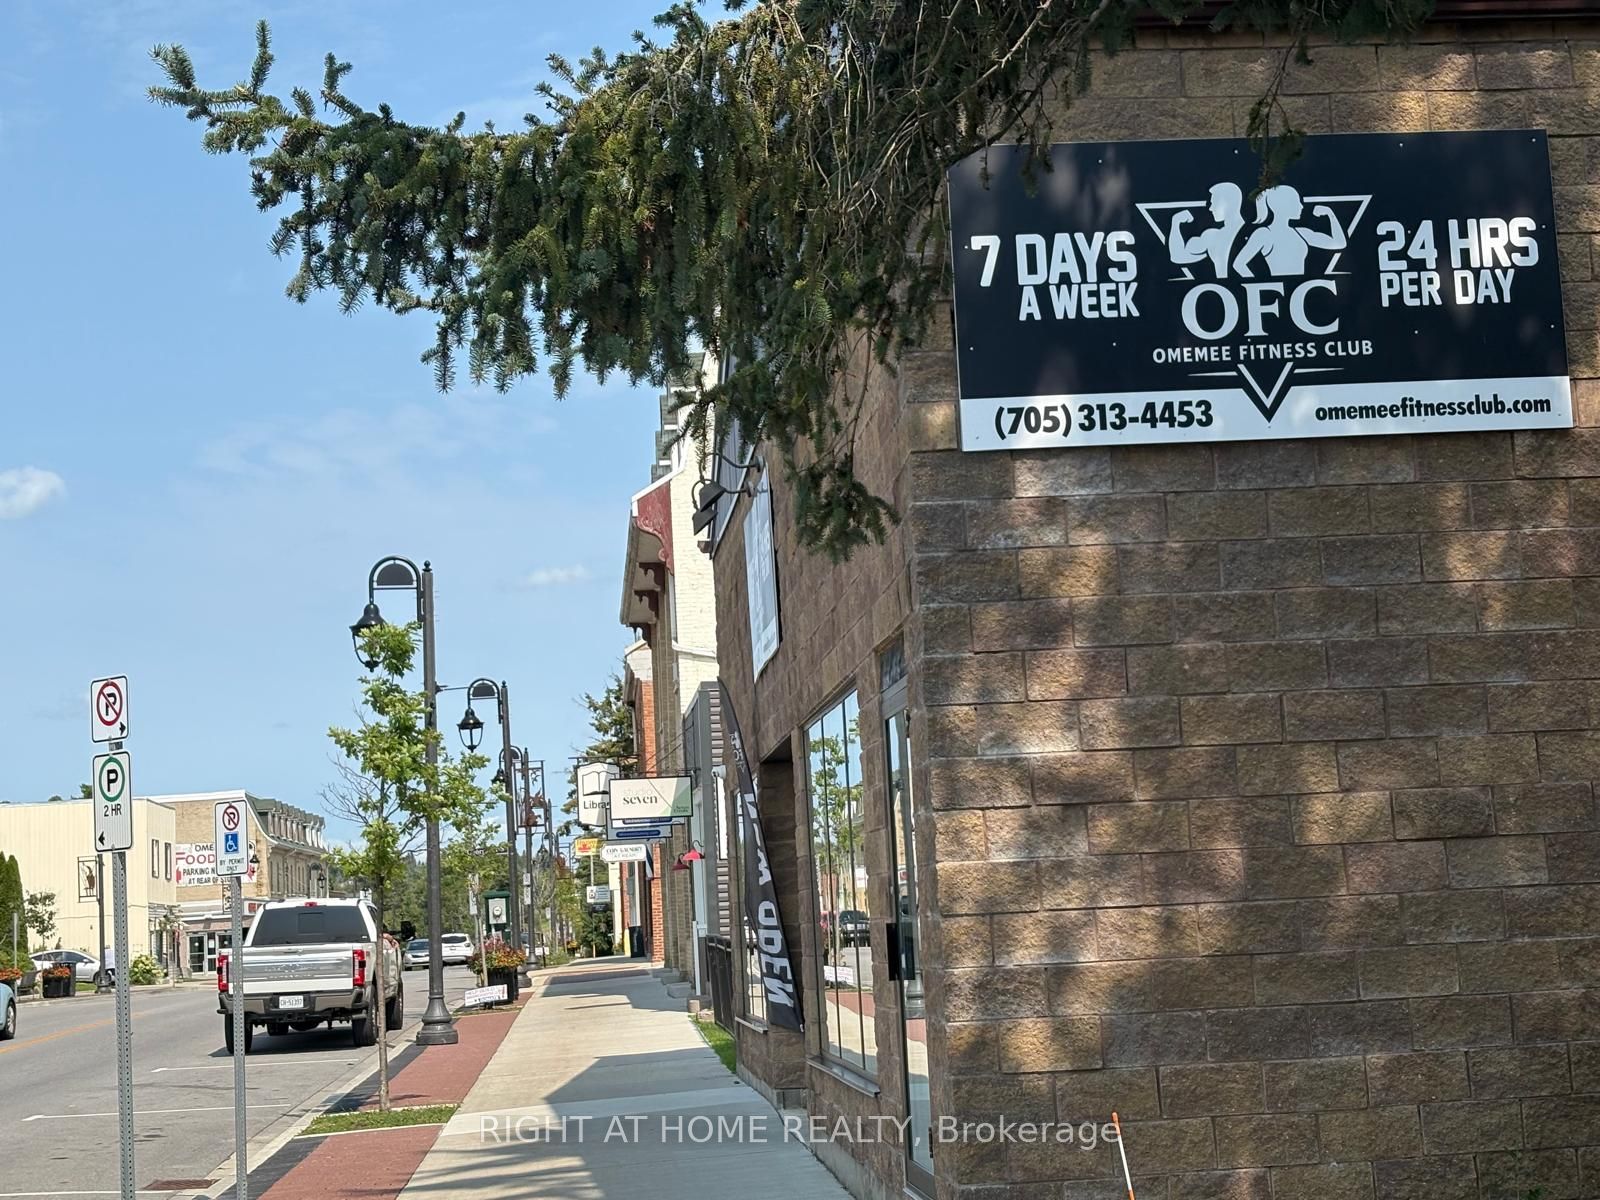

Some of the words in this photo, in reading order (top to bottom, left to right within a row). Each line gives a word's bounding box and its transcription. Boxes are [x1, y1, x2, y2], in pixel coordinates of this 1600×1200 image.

[1376, 219, 1438, 271] 24
[1447, 216, 1539, 269] HRS
[971, 234, 1001, 287] 7
[1015, 230, 1138, 286] DAYS
[1018, 285, 1042, 321] A
[1048, 281, 1140, 320] WEEK
[1379, 270, 1443, 308] PER
[1453, 268, 1515, 305] DAY
[1181, 280, 1339, 340] OFC
[1152, 346, 1232, 364] OMEMEE
[1239, 342, 1317, 361] FITNESS
[1324, 340, 1373, 357] CLUB
[994, 404, 1073, 441] (705)
[1077, 399, 1214, 432] 313-4453
[1315, 393, 1552, 421] omemeefitnessclub.com
[103, 804, 109, 817] 2
[111, 803, 122, 816] HR
[622, 795, 658, 805] seven
[176, 852, 216, 865] FOOD
[194, 843, 215, 852] OME
[182, 867, 209, 876] PARKING
